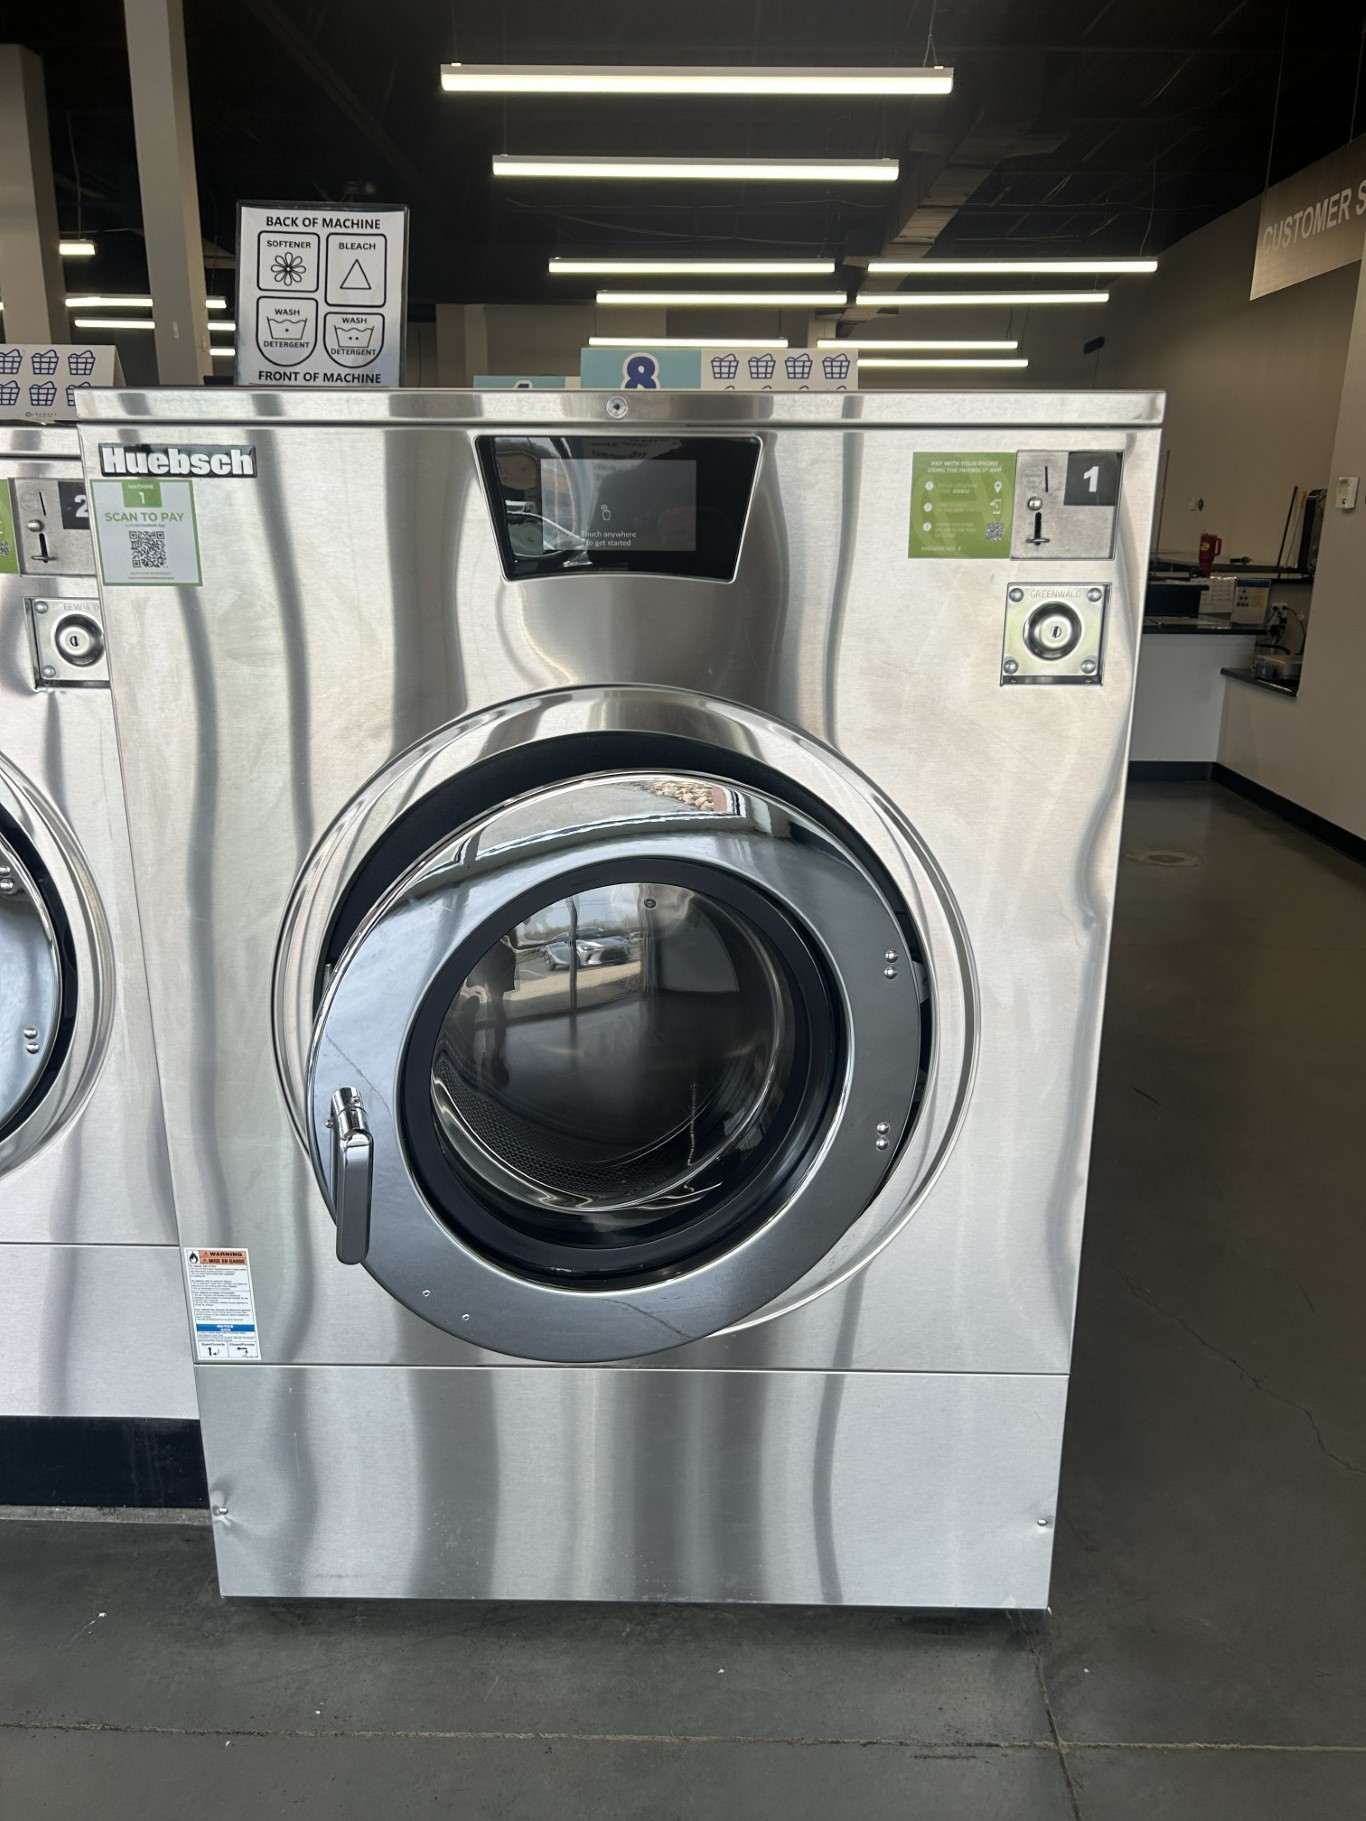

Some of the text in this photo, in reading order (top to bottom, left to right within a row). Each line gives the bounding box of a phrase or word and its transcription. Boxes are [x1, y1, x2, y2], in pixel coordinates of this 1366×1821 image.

[266, 216, 381, 229] BACK OF MACHINE
[1262, 188, 1352, 253] CUSTOMER
[266, 240, 311, 249] SOFTENER
[338, 242, 376, 250] BLEACH
[274, 308, 300, 316] WASH
[330, 348, 376, 356] DETERGENT
[624, 353, 659, 389] 8
[258, 371, 381, 384] FRONT OF MACHINE
[102, 447, 253, 475] Huebsch
[1083, 466, 1100, 492] 1
[139, 492, 146, 504] 1
[74, 494, 89, 518] 2
[104, 512, 184, 522] SCAN TO PAY
[582, 530, 637, 539] Touch anywhere
[1030, 590, 1081, 599] GREENWALD
